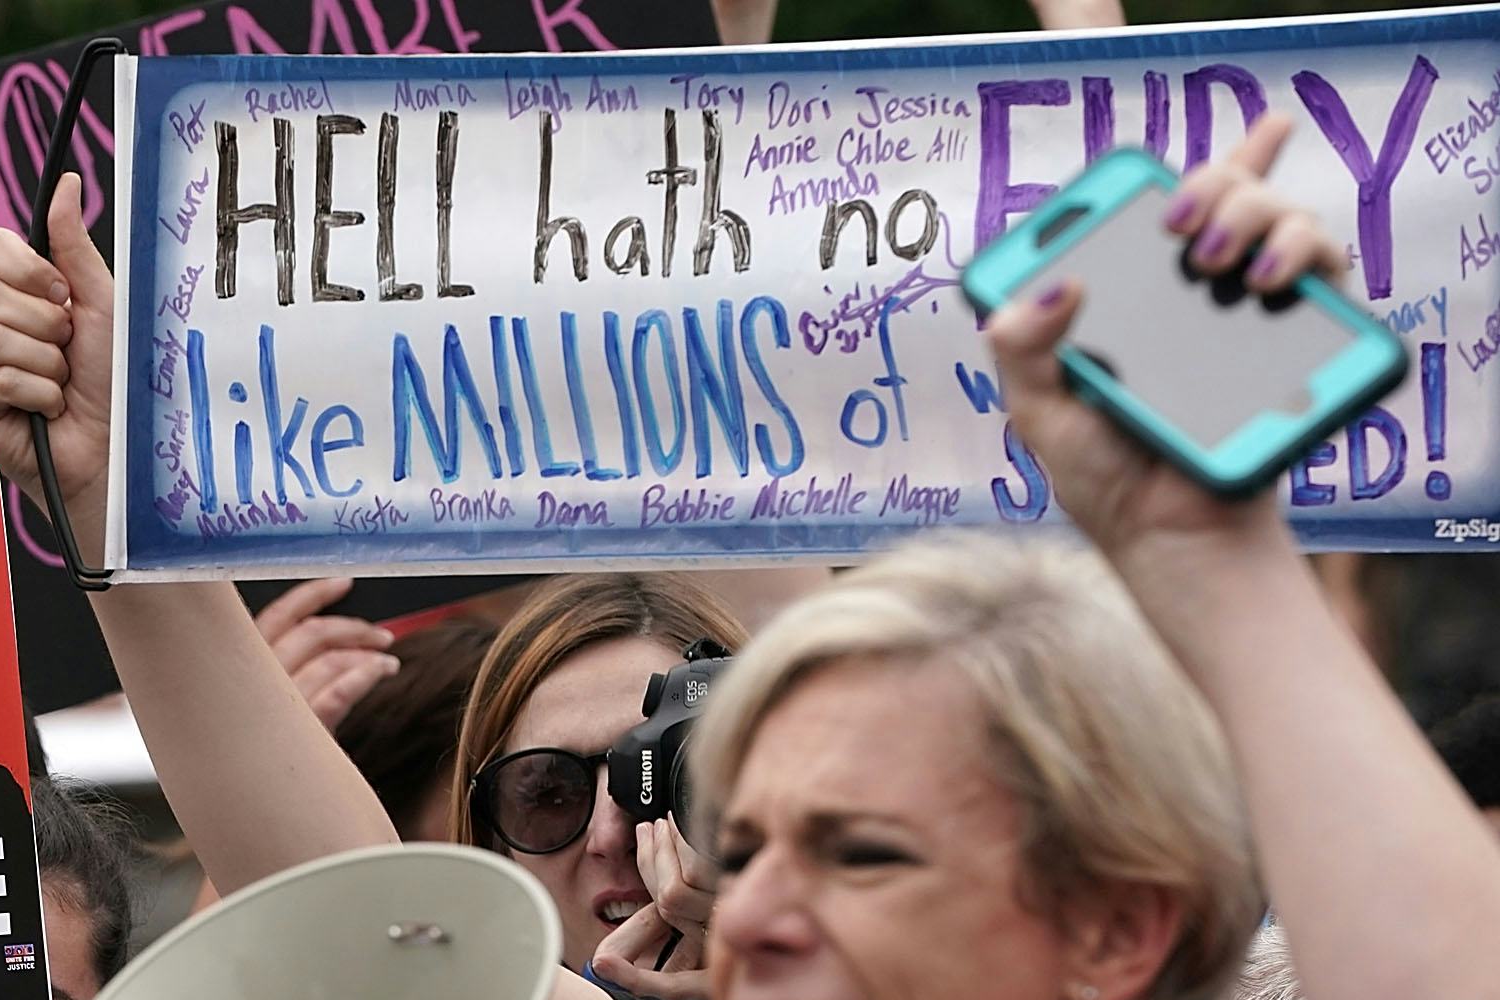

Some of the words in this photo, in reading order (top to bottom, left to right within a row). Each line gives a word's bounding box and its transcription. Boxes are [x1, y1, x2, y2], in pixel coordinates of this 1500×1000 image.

[169, 98, 206, 154] Pat
[245, 76, 336, 122] Rachel
[394, 78, 477, 111] Maria
[504, 71, 571, 133] Leigh
[586, 74, 639, 113] Ann
[669, 74, 745, 125] Tory
[768, 81, 832, 130] Dori
[855, 85, 972, 129] Jessica
[1424, 69, 1500, 174] Elizabe
[744, 134, 820, 178] Annie
[836, 127, 917, 167] Chloe
[158, 166, 210, 245] Laura
[214, 110, 476, 306] HELL
[533, 107, 750, 282] hath
[819, 188, 939, 270] no
[768, 162, 879, 216] Amanda
[148, 329, 188, 399] Emily
[187, 324, 365, 514] like
[392, 295, 805, 483] MILLIONS
[840, 294, 908, 448] of
[197, 490, 308, 542] Melinda
[333, 496, 410, 536] Krista
[534, 492, 615, 529] Dana
[640, 484, 735, 530] Bobbie
[750, 472, 867, 521] Michelle
[687, 680, 698, 702] EOS
[698, 682, 708, 696] 5D
[640, 750, 653, 805] Canon
[7, 963, 36, 971] JUSTICE
